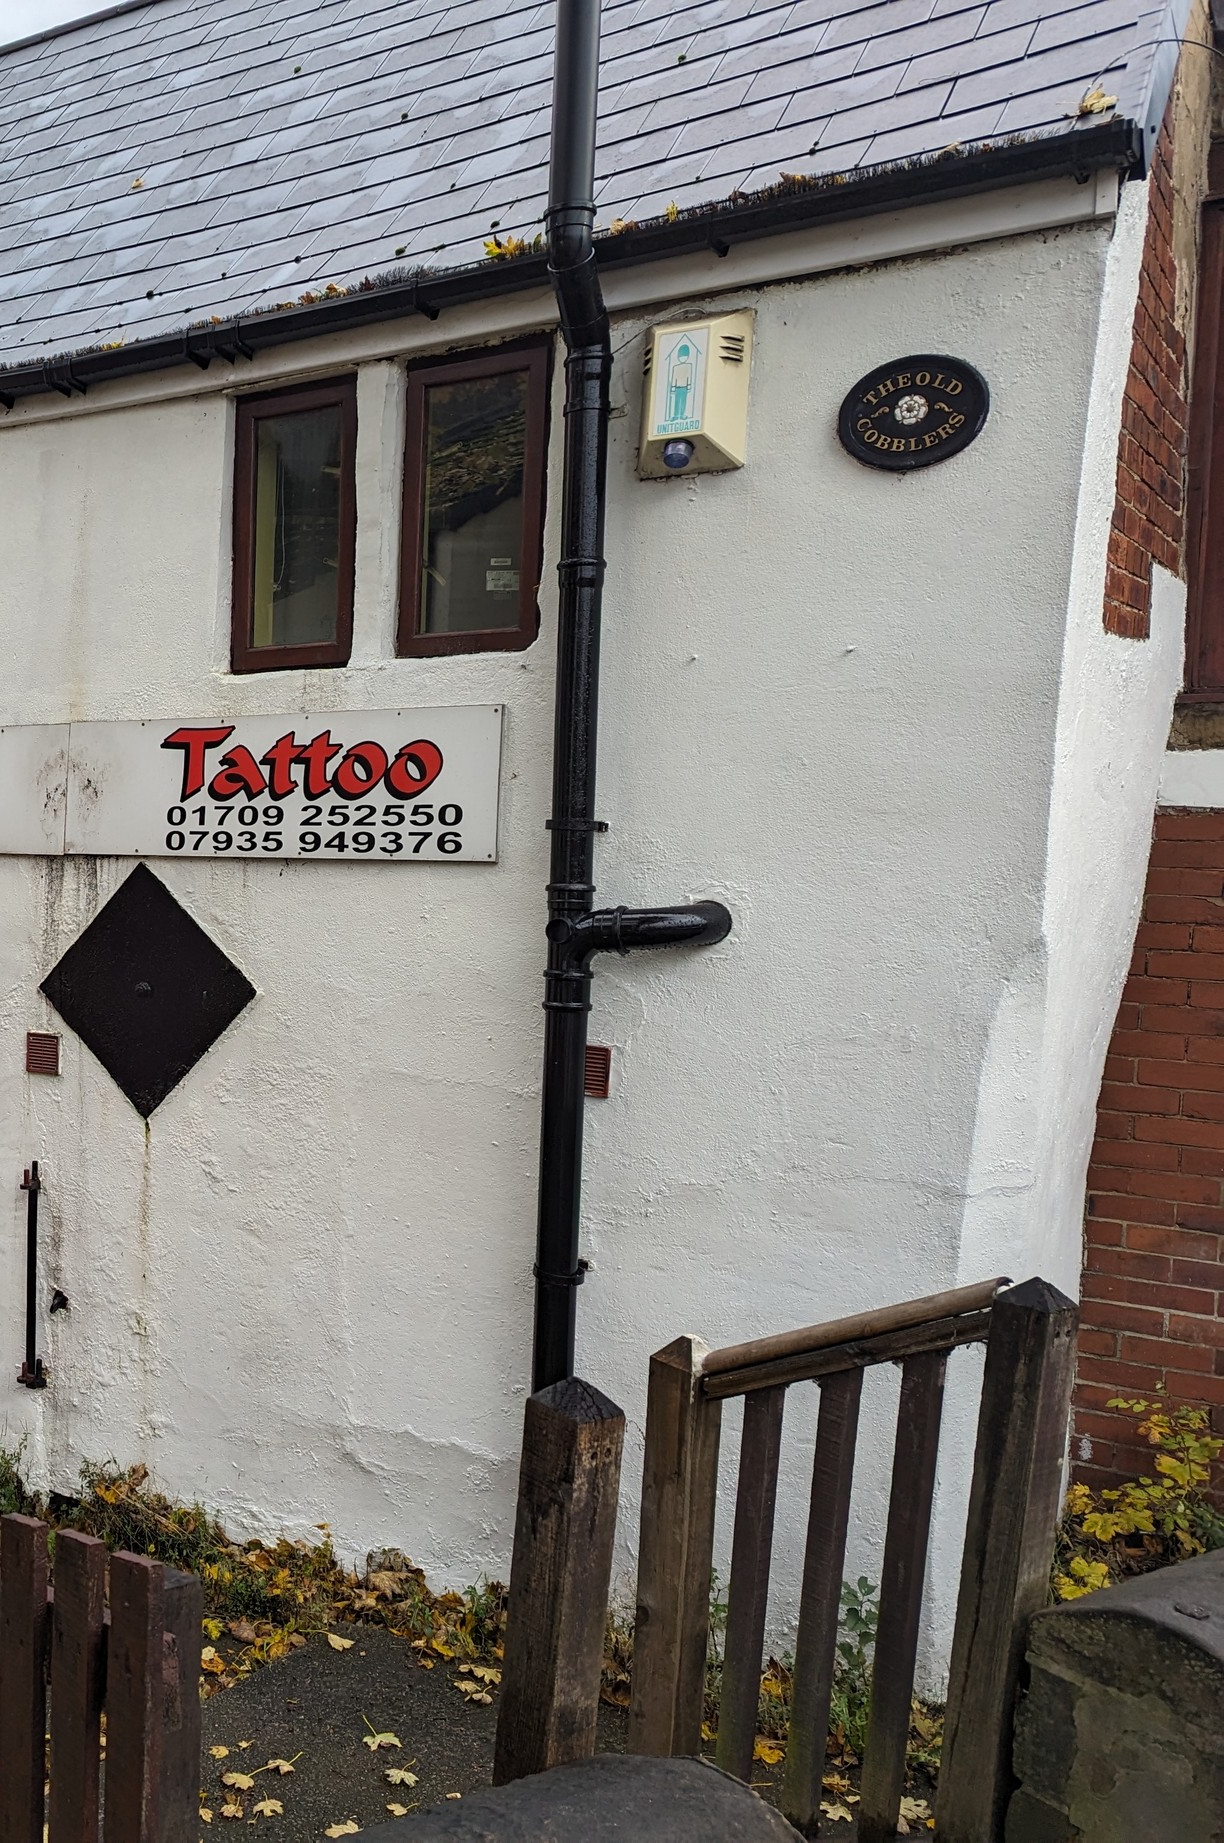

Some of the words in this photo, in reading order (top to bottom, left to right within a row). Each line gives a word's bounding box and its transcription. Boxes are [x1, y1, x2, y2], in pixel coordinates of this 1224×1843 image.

[863, 373, 912, 405] THE
[916, 371, 963, 396] OLD
[856, 412, 965, 452] COBBLERS
[160, 725, 444, 803] Tattoo
[166, 804, 285, 827] 01709
[299, 803, 464, 827] 252550
[165, 830, 284, 852] 07935
[298, 830, 464, 855] 949376
